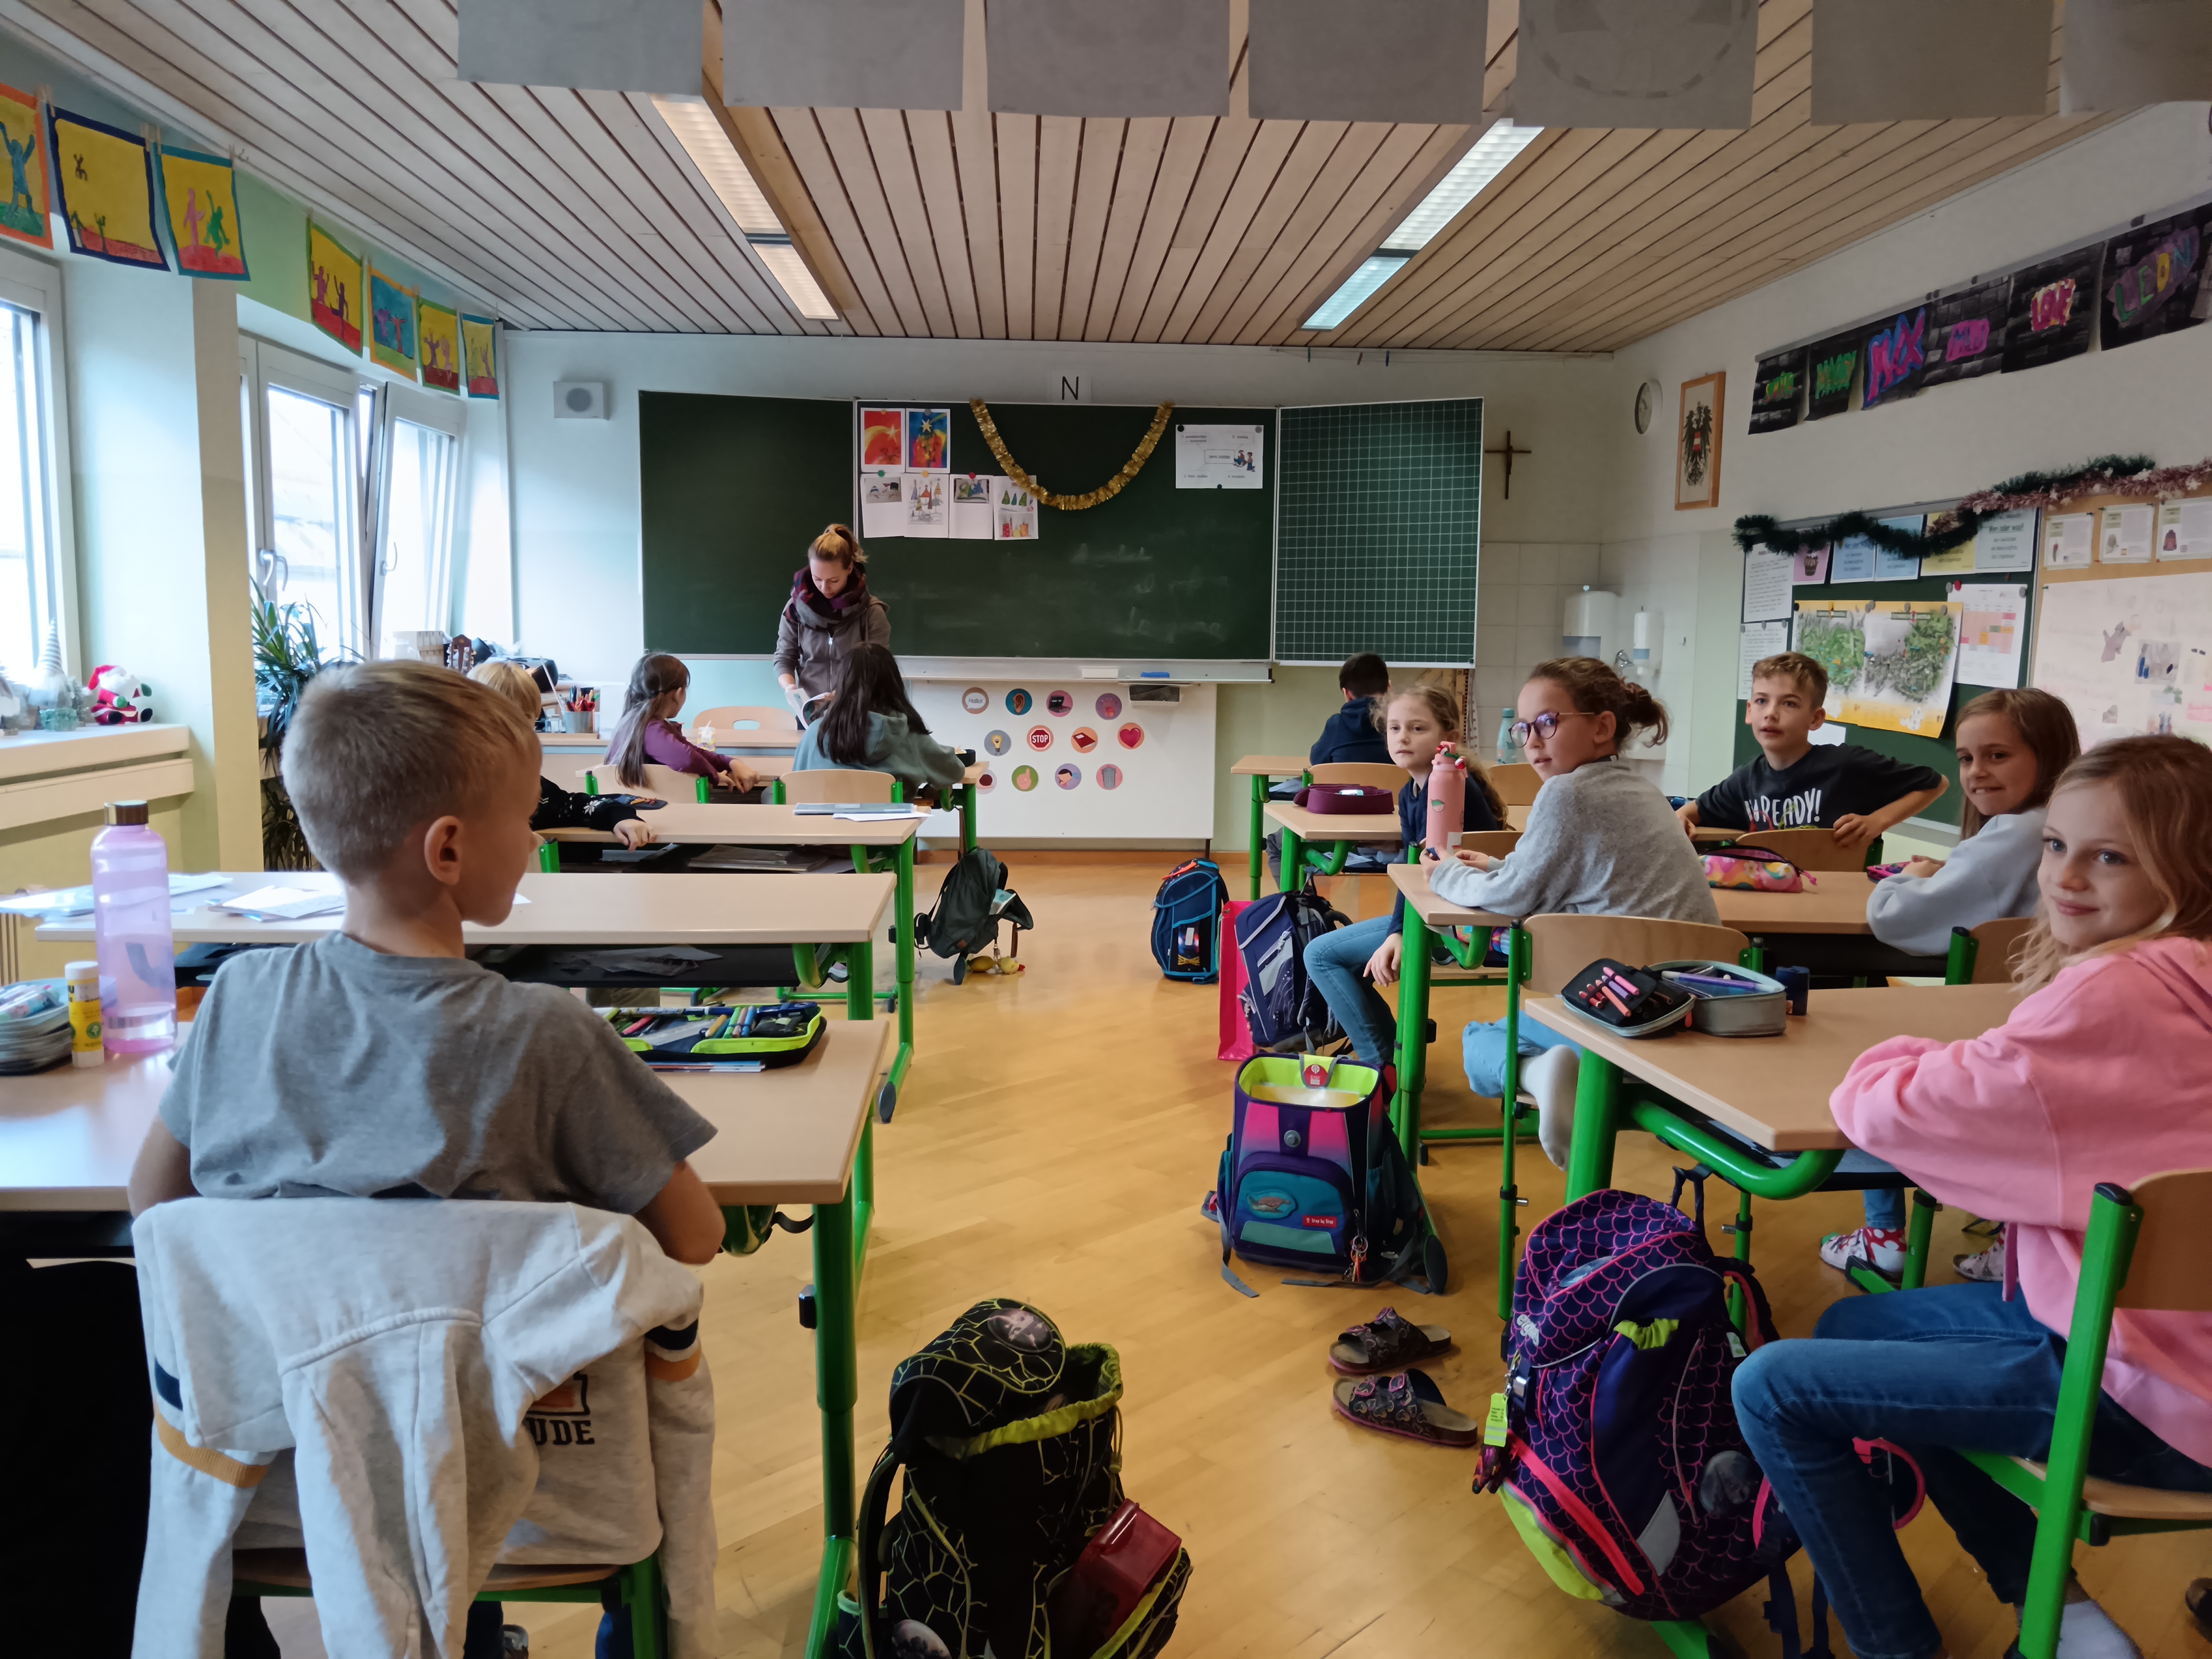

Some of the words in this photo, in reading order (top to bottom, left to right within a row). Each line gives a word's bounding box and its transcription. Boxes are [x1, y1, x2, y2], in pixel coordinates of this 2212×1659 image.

[2115, 235, 2192, 322] LEON
[1062, 376, 1079, 400] N
[1032, 734, 1048, 743] STOP
[1760, 787, 1821, 826] READY!
